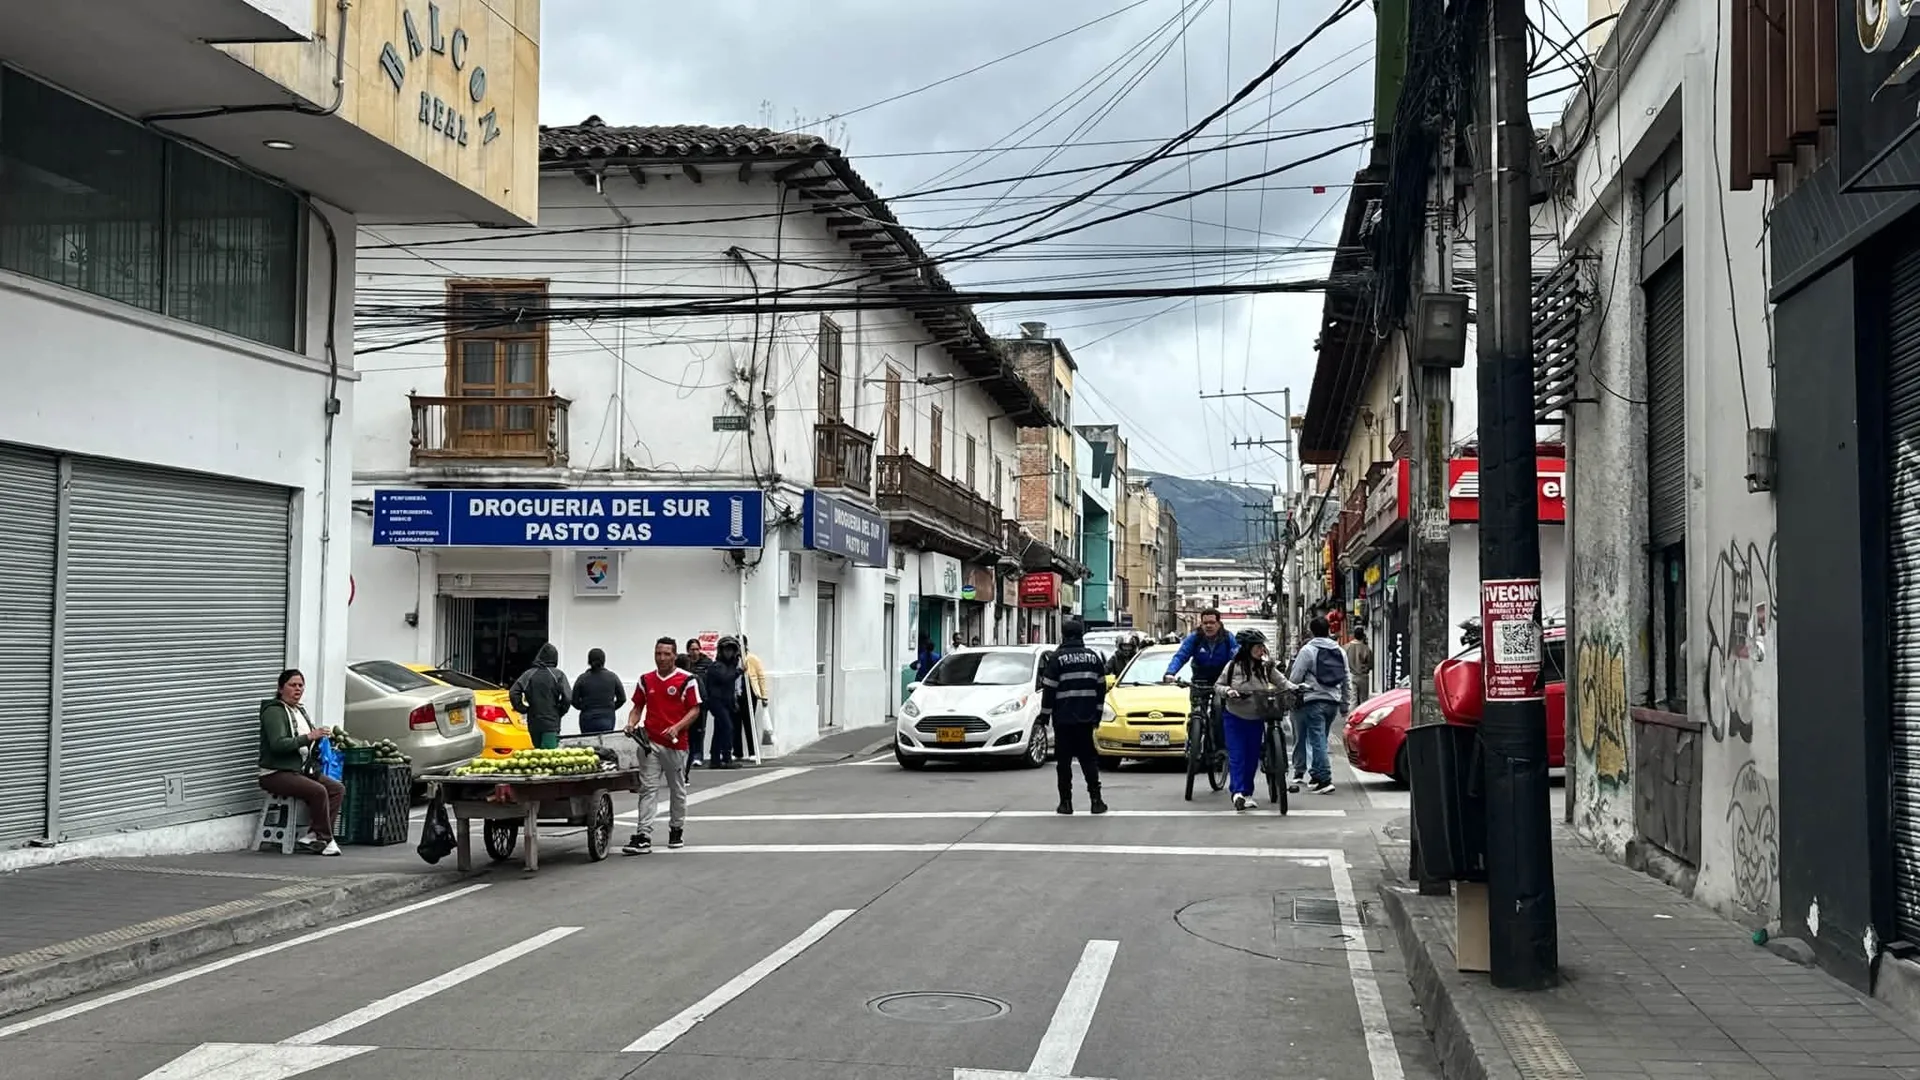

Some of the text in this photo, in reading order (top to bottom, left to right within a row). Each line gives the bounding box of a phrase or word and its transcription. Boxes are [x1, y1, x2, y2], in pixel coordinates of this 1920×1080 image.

[418, 90, 468, 147] REAL
[469, 498, 711, 517] DROGUERIA DEL SUR
[525, 522, 652, 541] PASTO SAS
